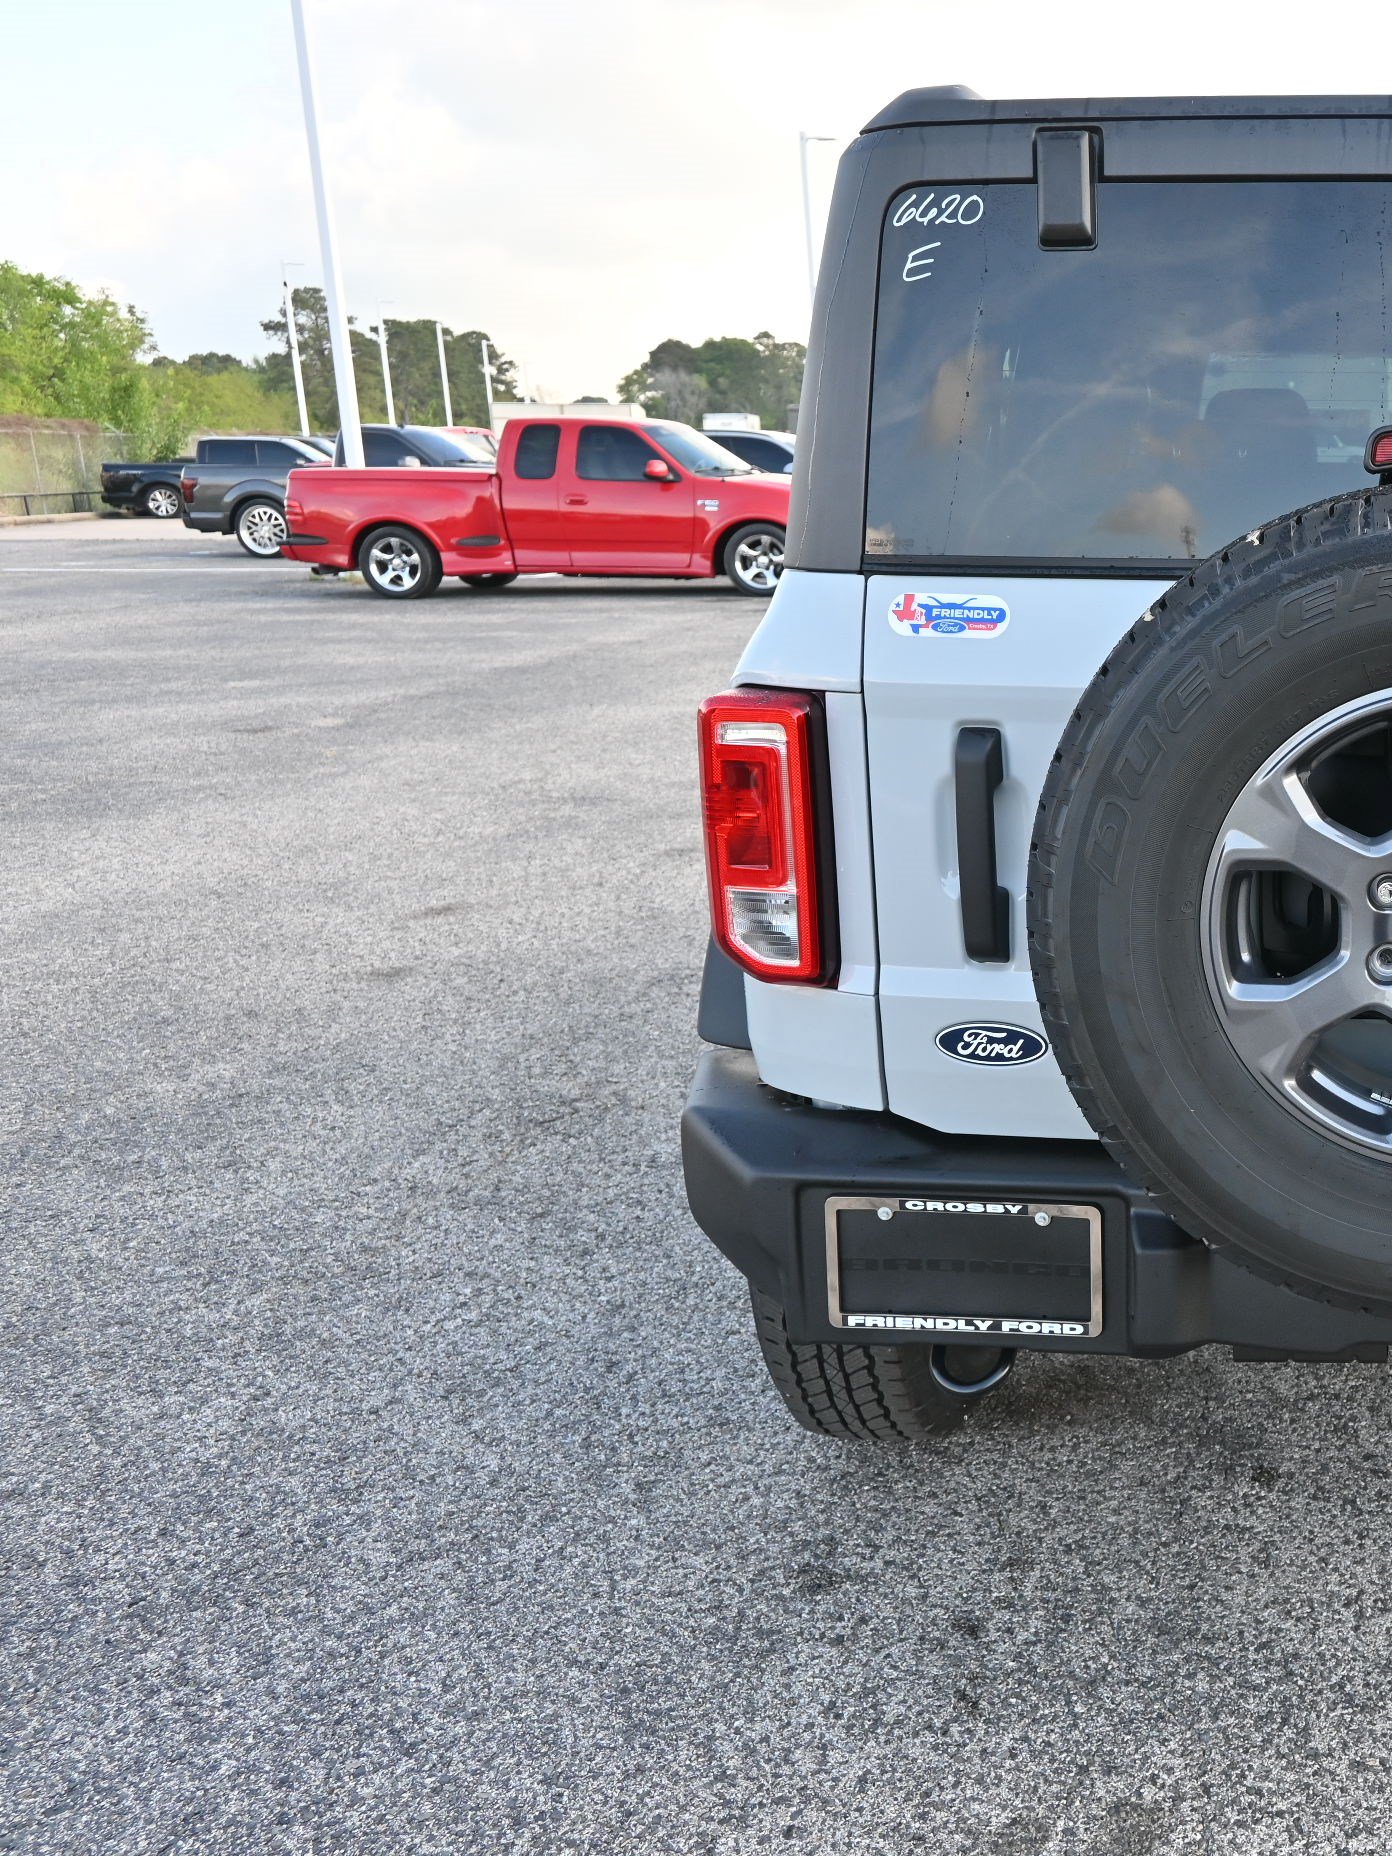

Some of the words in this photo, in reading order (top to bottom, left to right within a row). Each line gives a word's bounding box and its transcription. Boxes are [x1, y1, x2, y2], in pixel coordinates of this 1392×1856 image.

[902, 241, 941, 282] E
[931, 608, 1000, 619] FRIENDLY
[937, 620, 960, 632] Ford
[956, 1029, 1025, 1059] Ford
[905, 1200, 1023, 1214] CROSBY
[847, 1315, 993, 1332] FRIENDLY
[1001, 1321, 1084, 1335] FORD
